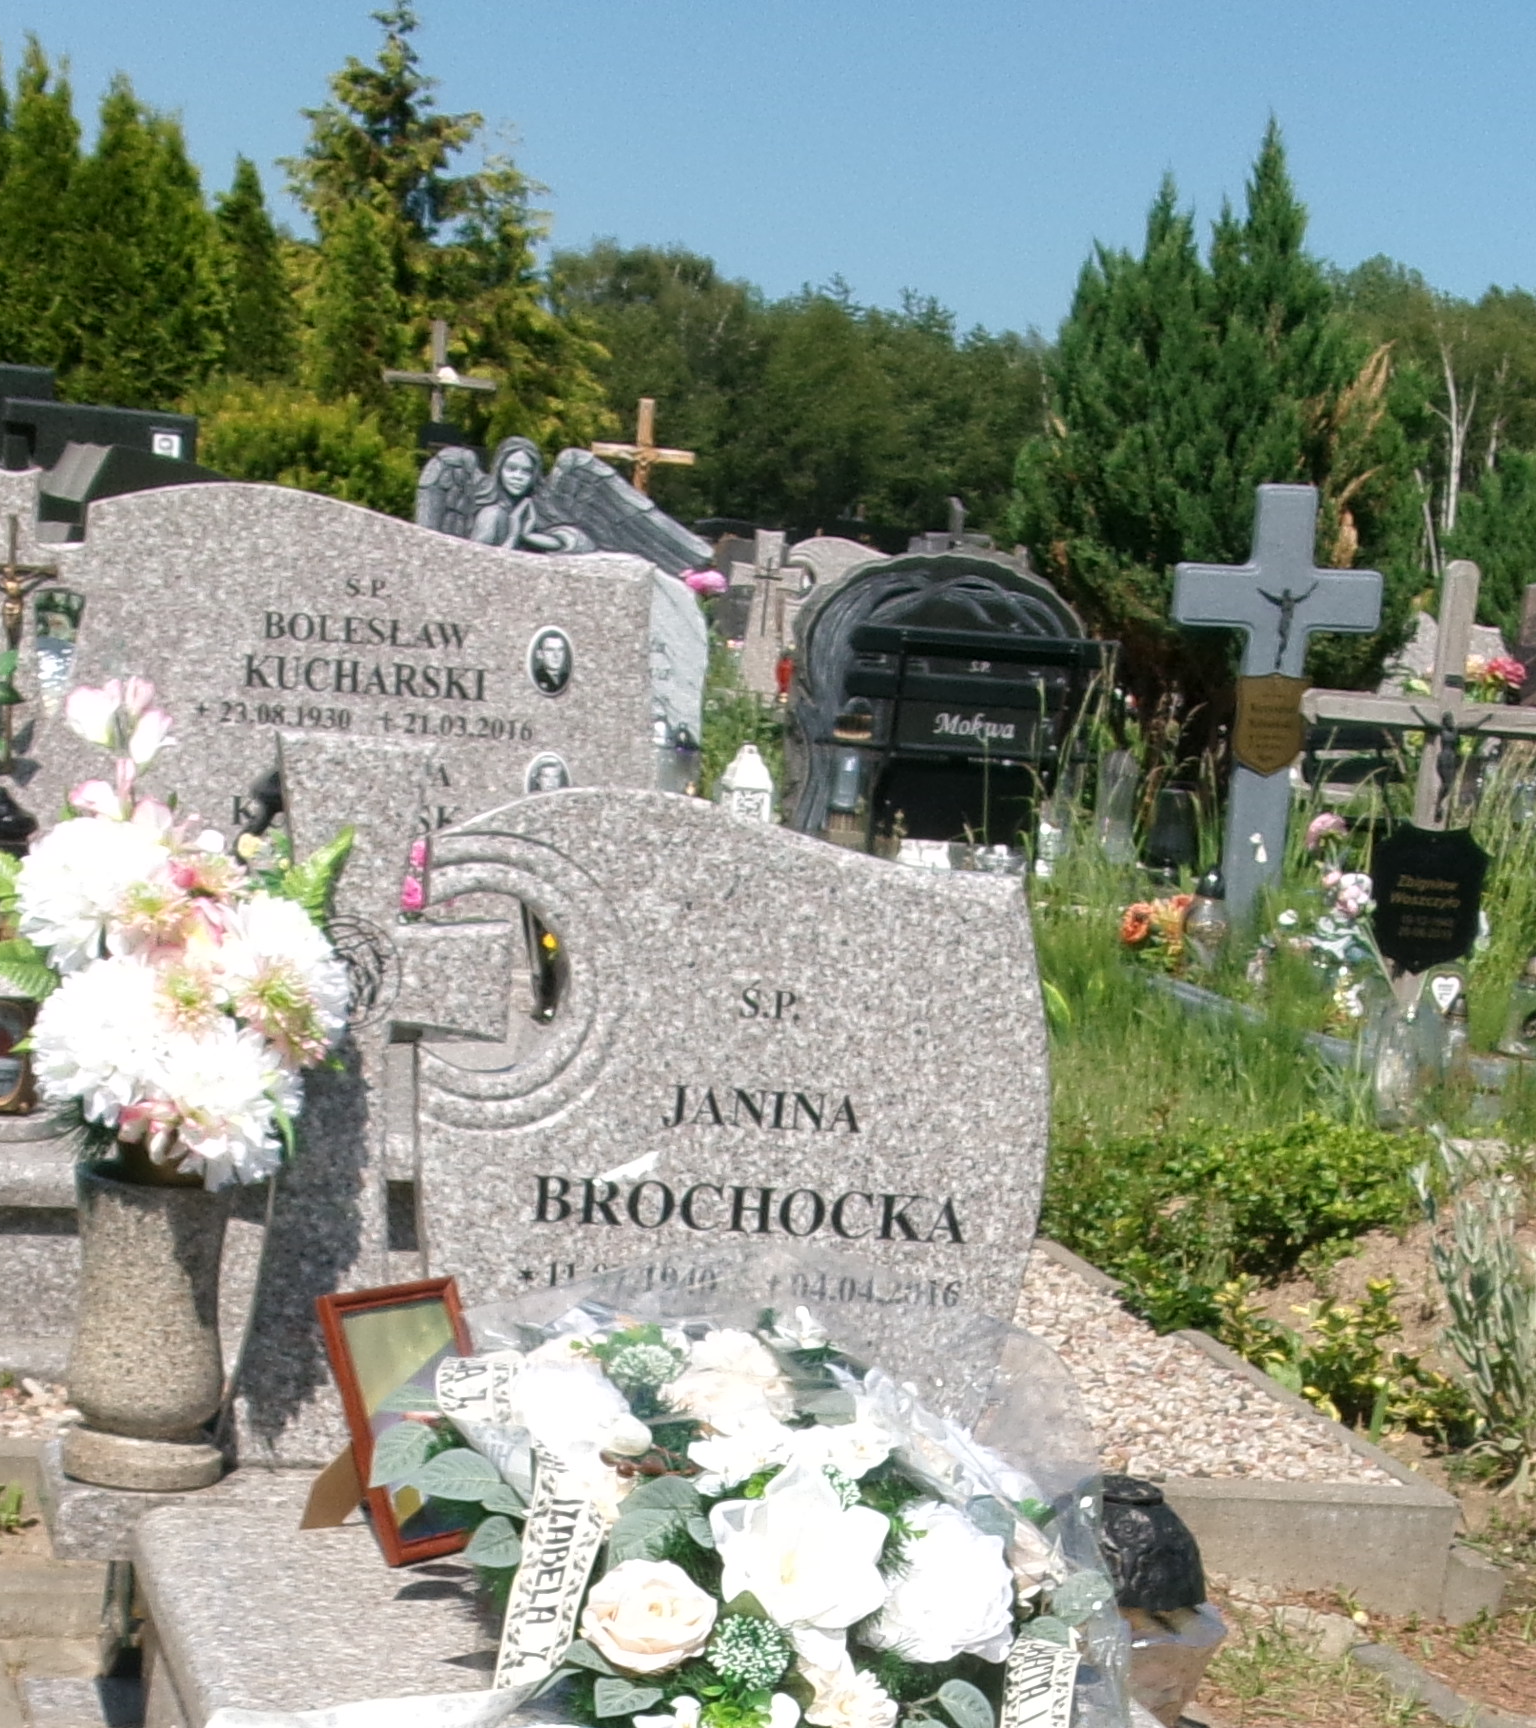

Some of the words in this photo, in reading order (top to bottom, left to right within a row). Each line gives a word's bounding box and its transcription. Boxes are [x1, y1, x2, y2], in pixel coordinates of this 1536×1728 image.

[264, 610, 469, 650] BOLESŁAW
[244, 654, 487, 702] KUCHARSKI
[932, 713, 1015, 741] Mokwa
[662, 1084, 860, 1133] JANINA
[534, 1175, 965, 1244] BROCHOCKA
[525, 1498, 585, 1625] IZABELA
